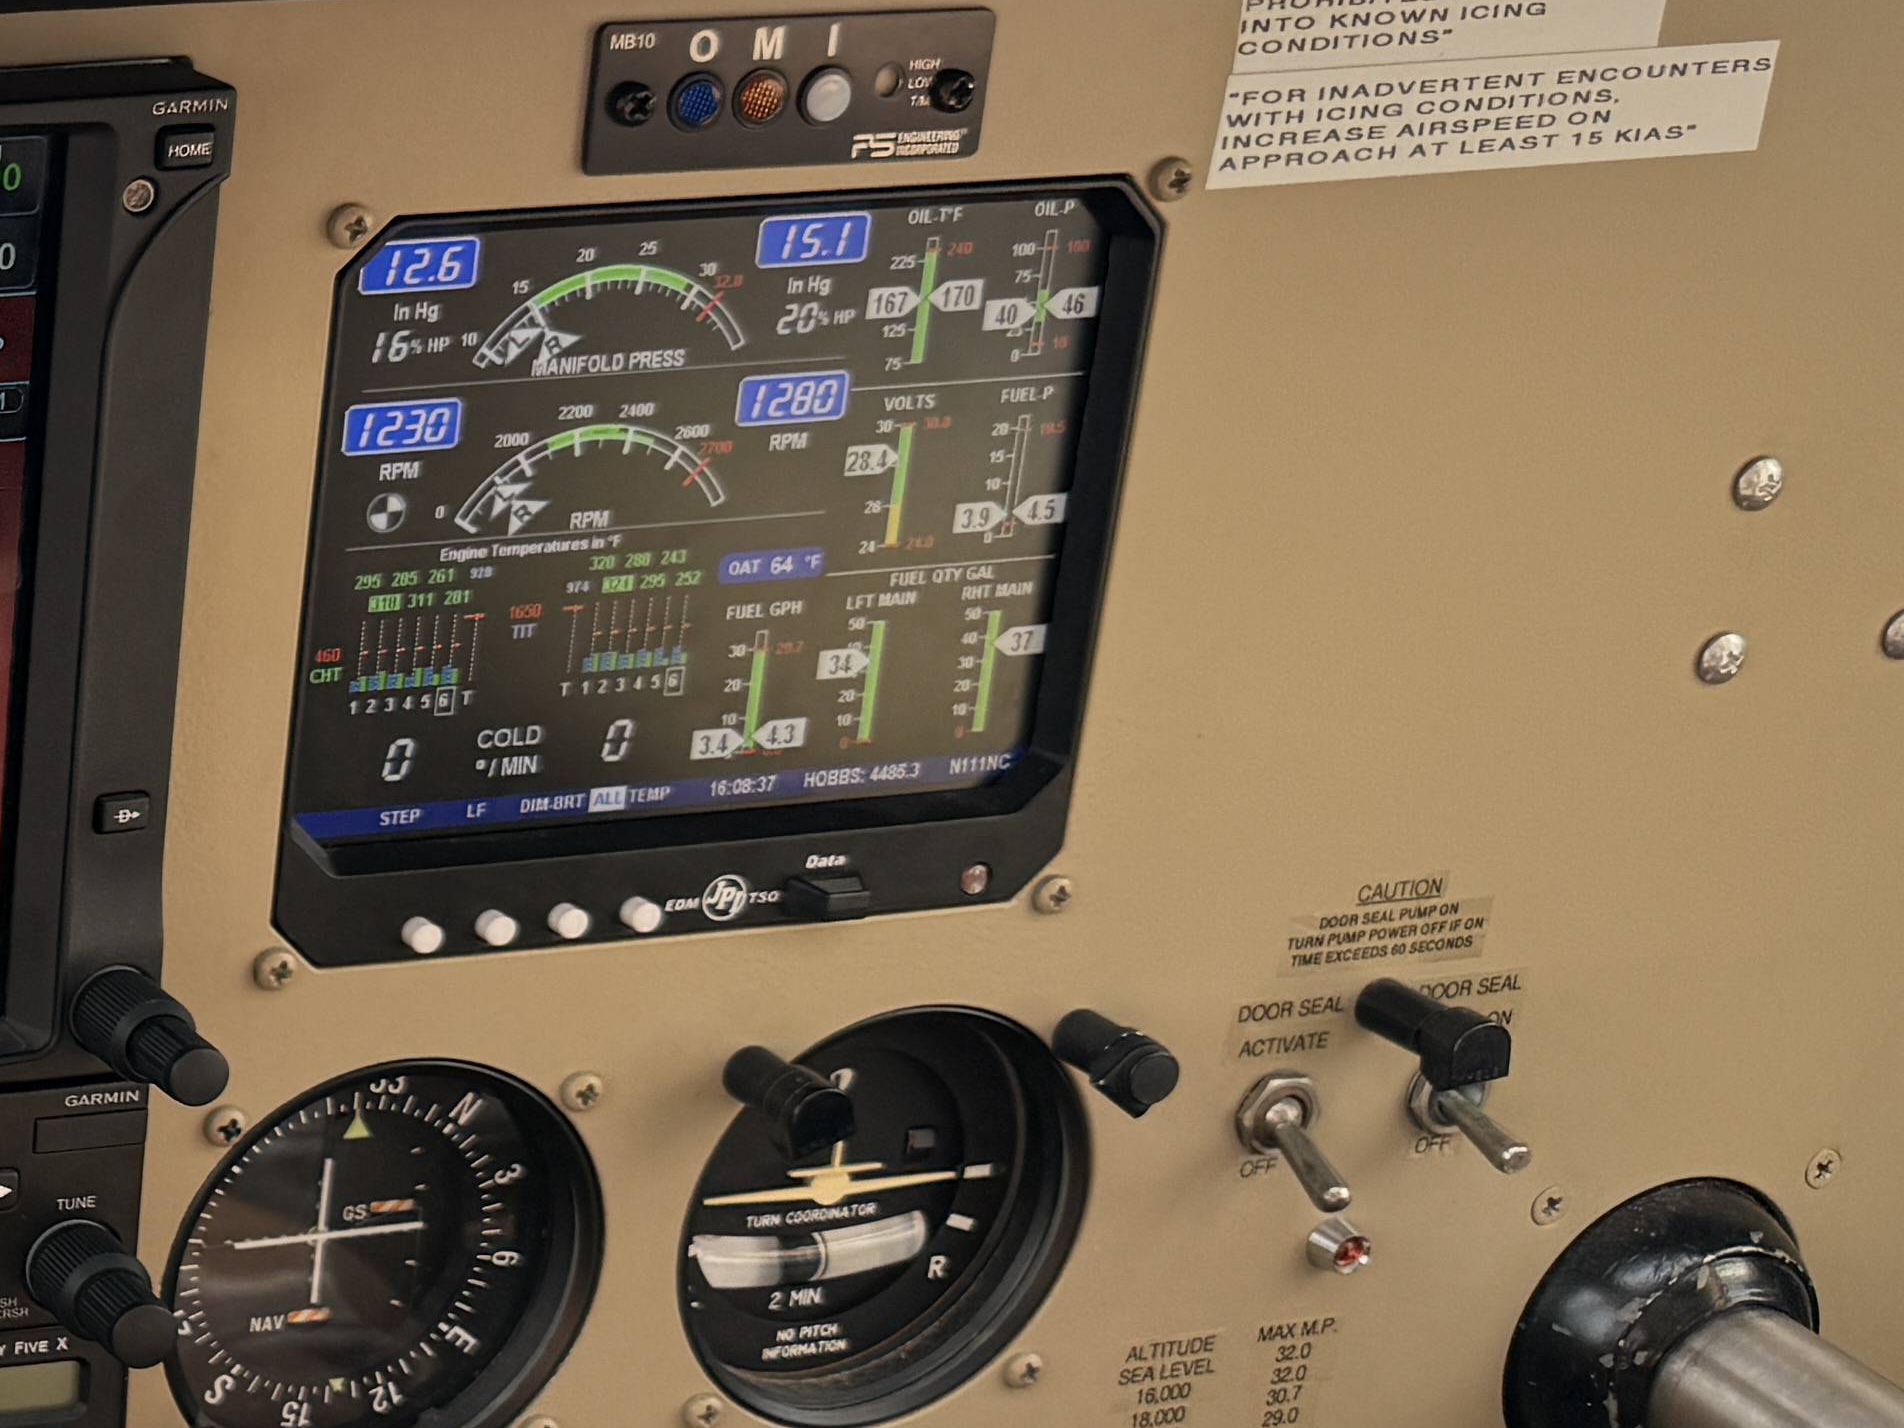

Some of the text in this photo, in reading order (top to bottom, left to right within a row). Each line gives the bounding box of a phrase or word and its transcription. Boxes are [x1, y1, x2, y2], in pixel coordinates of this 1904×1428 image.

[1240, 1, 1548, 35] INTO KNOWN ICING
[610, 33, 656, 49] MB10
[1317, 72, 1546, 102] INADVERTENT
[1556, 57, 1772, 86] ENCOUNTERS
[152, 98, 229, 116] GARMIN
[1226, 109, 1305, 129] WITH
[1315, 102, 1404, 122] ICING
[1220, 109, 1611, 150] INCREASE AIRSPEED ON
[168, 142, 212, 157] HOME
[1218, 144, 1396, 172] APPROACH
[1408, 141, 1447, 158] AT
[1459, 134, 1562, 156] LEAST
[1572, 130, 1603, 146] 15
[533, 349, 684, 376] MANIFOLD PRESS
[741, 380, 840, 418] 1280
[884, 393, 935, 413] VOLTS
[352, 407, 449, 447] 1230
[1238, 1032, 1328, 1058] ACTIVATE
[14, 1340, 50, 1357] FIVE
[56, 1338, 69, 1350] X
